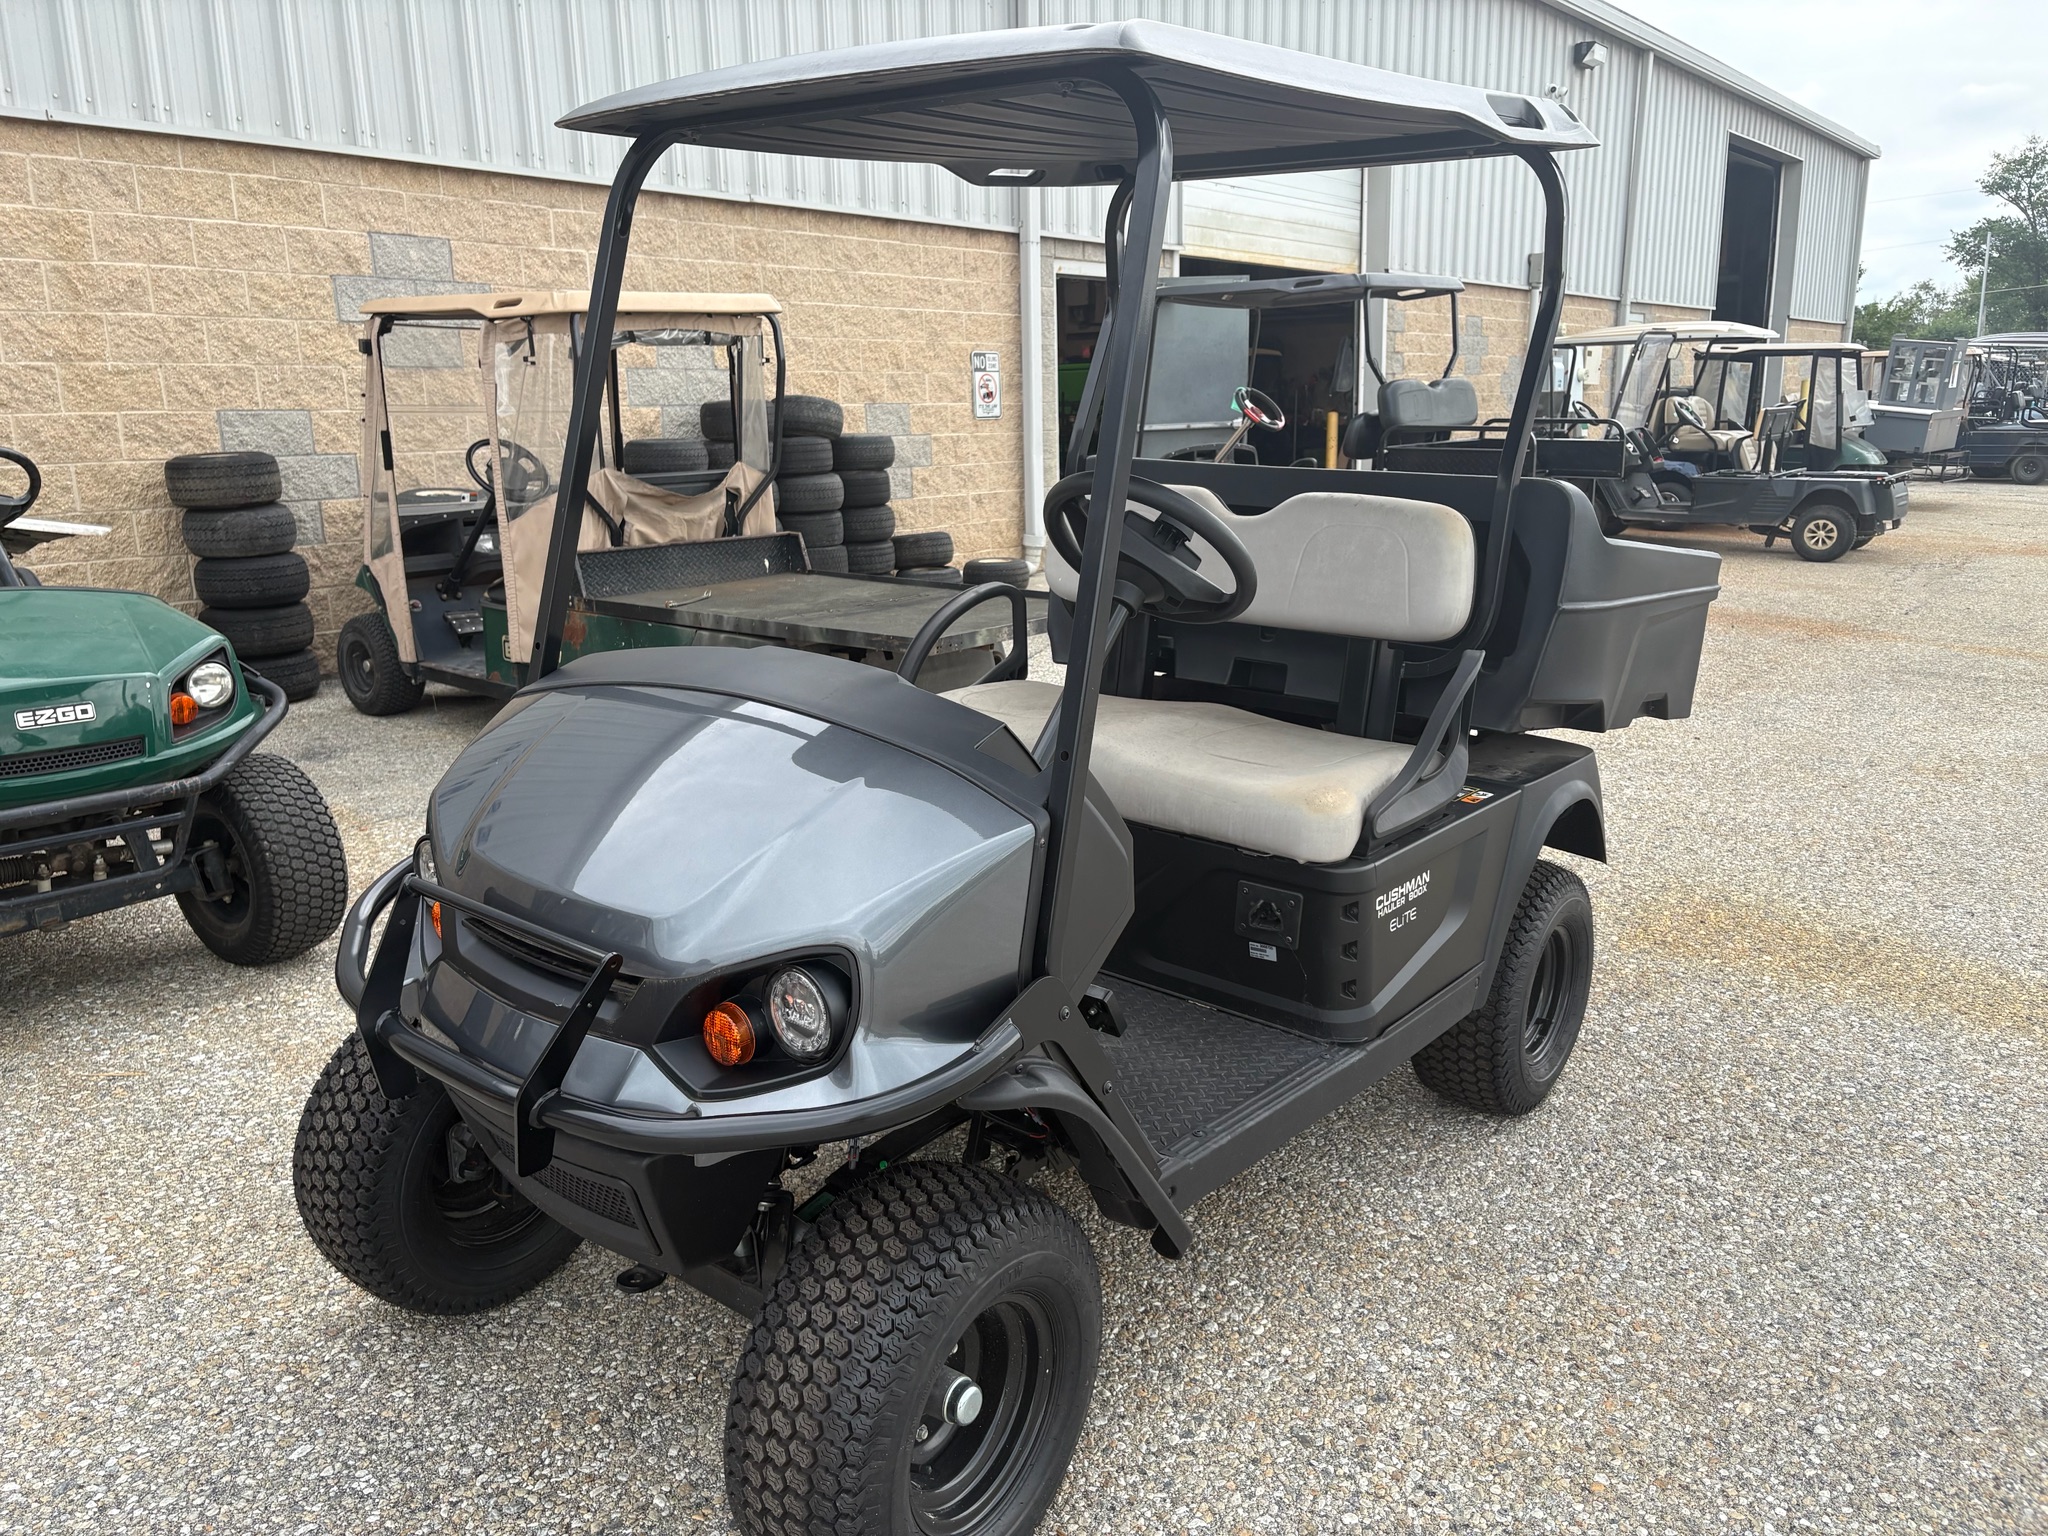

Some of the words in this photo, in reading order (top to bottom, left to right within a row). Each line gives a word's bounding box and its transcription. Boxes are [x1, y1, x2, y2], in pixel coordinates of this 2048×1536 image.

[974, 355, 986, 369] NO
[1376, 870, 1430, 911] CUSHMAN
[1377, 896, 1405, 919] HAULER
